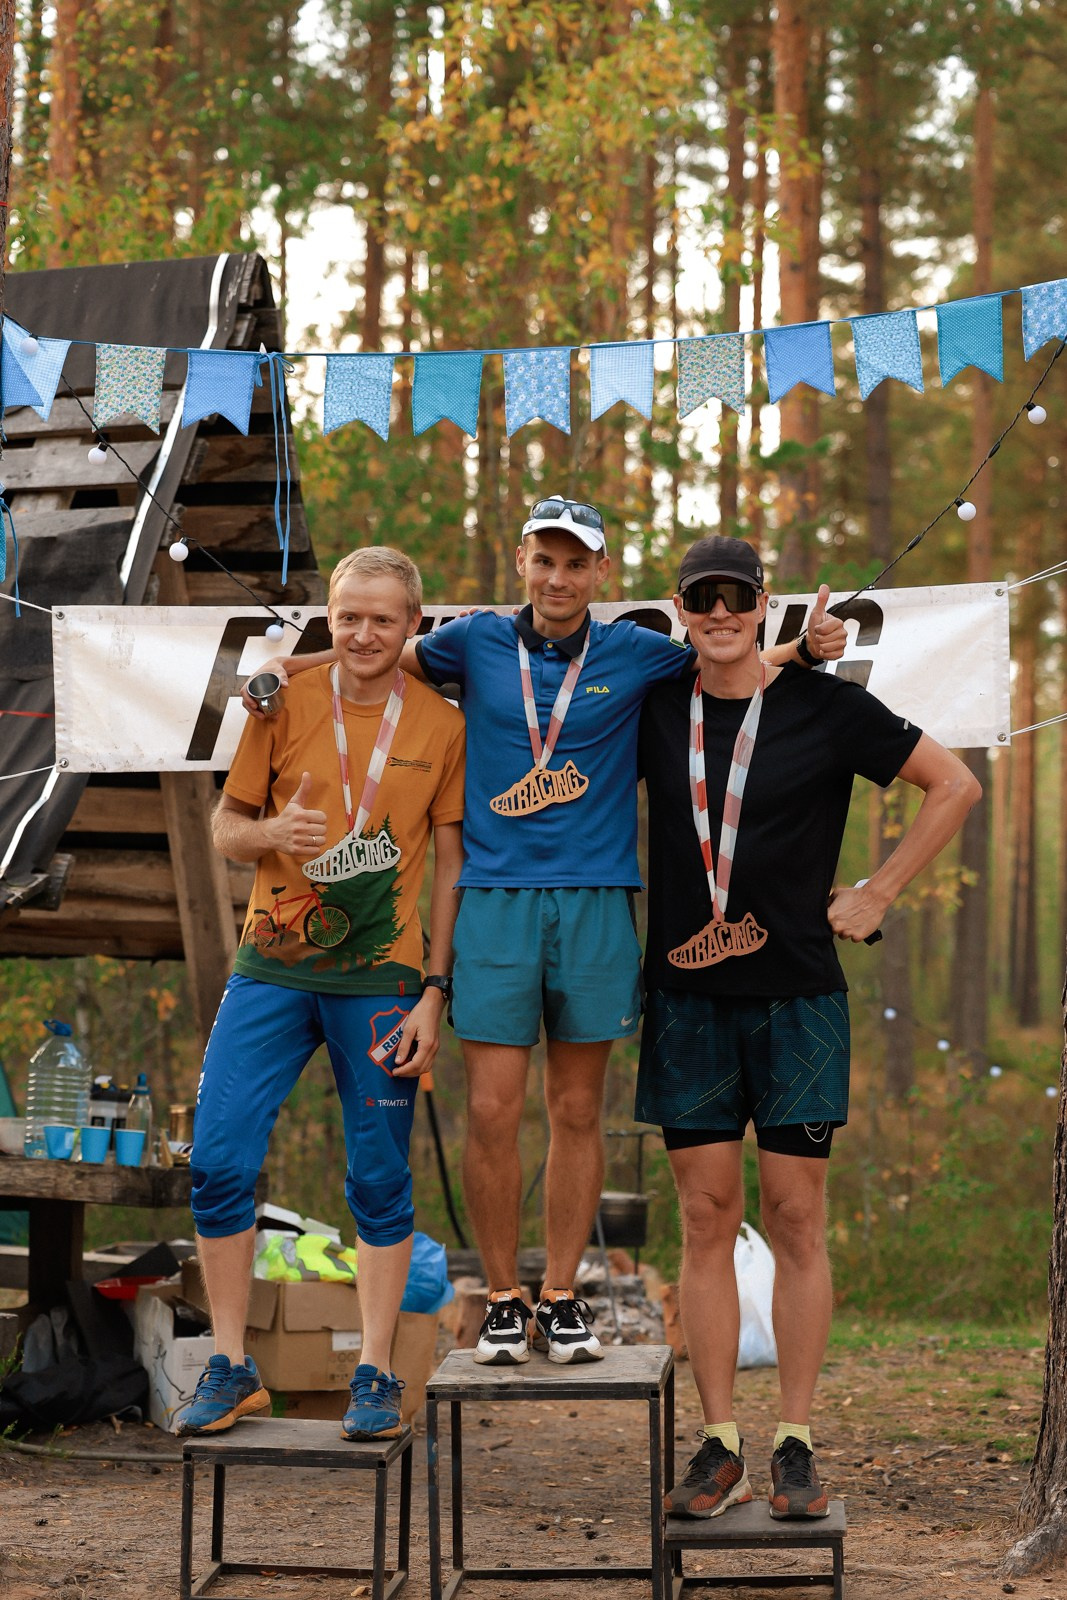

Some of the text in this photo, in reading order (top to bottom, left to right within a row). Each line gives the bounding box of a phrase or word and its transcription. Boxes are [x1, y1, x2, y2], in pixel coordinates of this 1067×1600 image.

[586, 686, 610, 694] FILA
[382, 1026, 404, 1053] RBK
[377, 1098, 409, 1108] TRIMTEX
